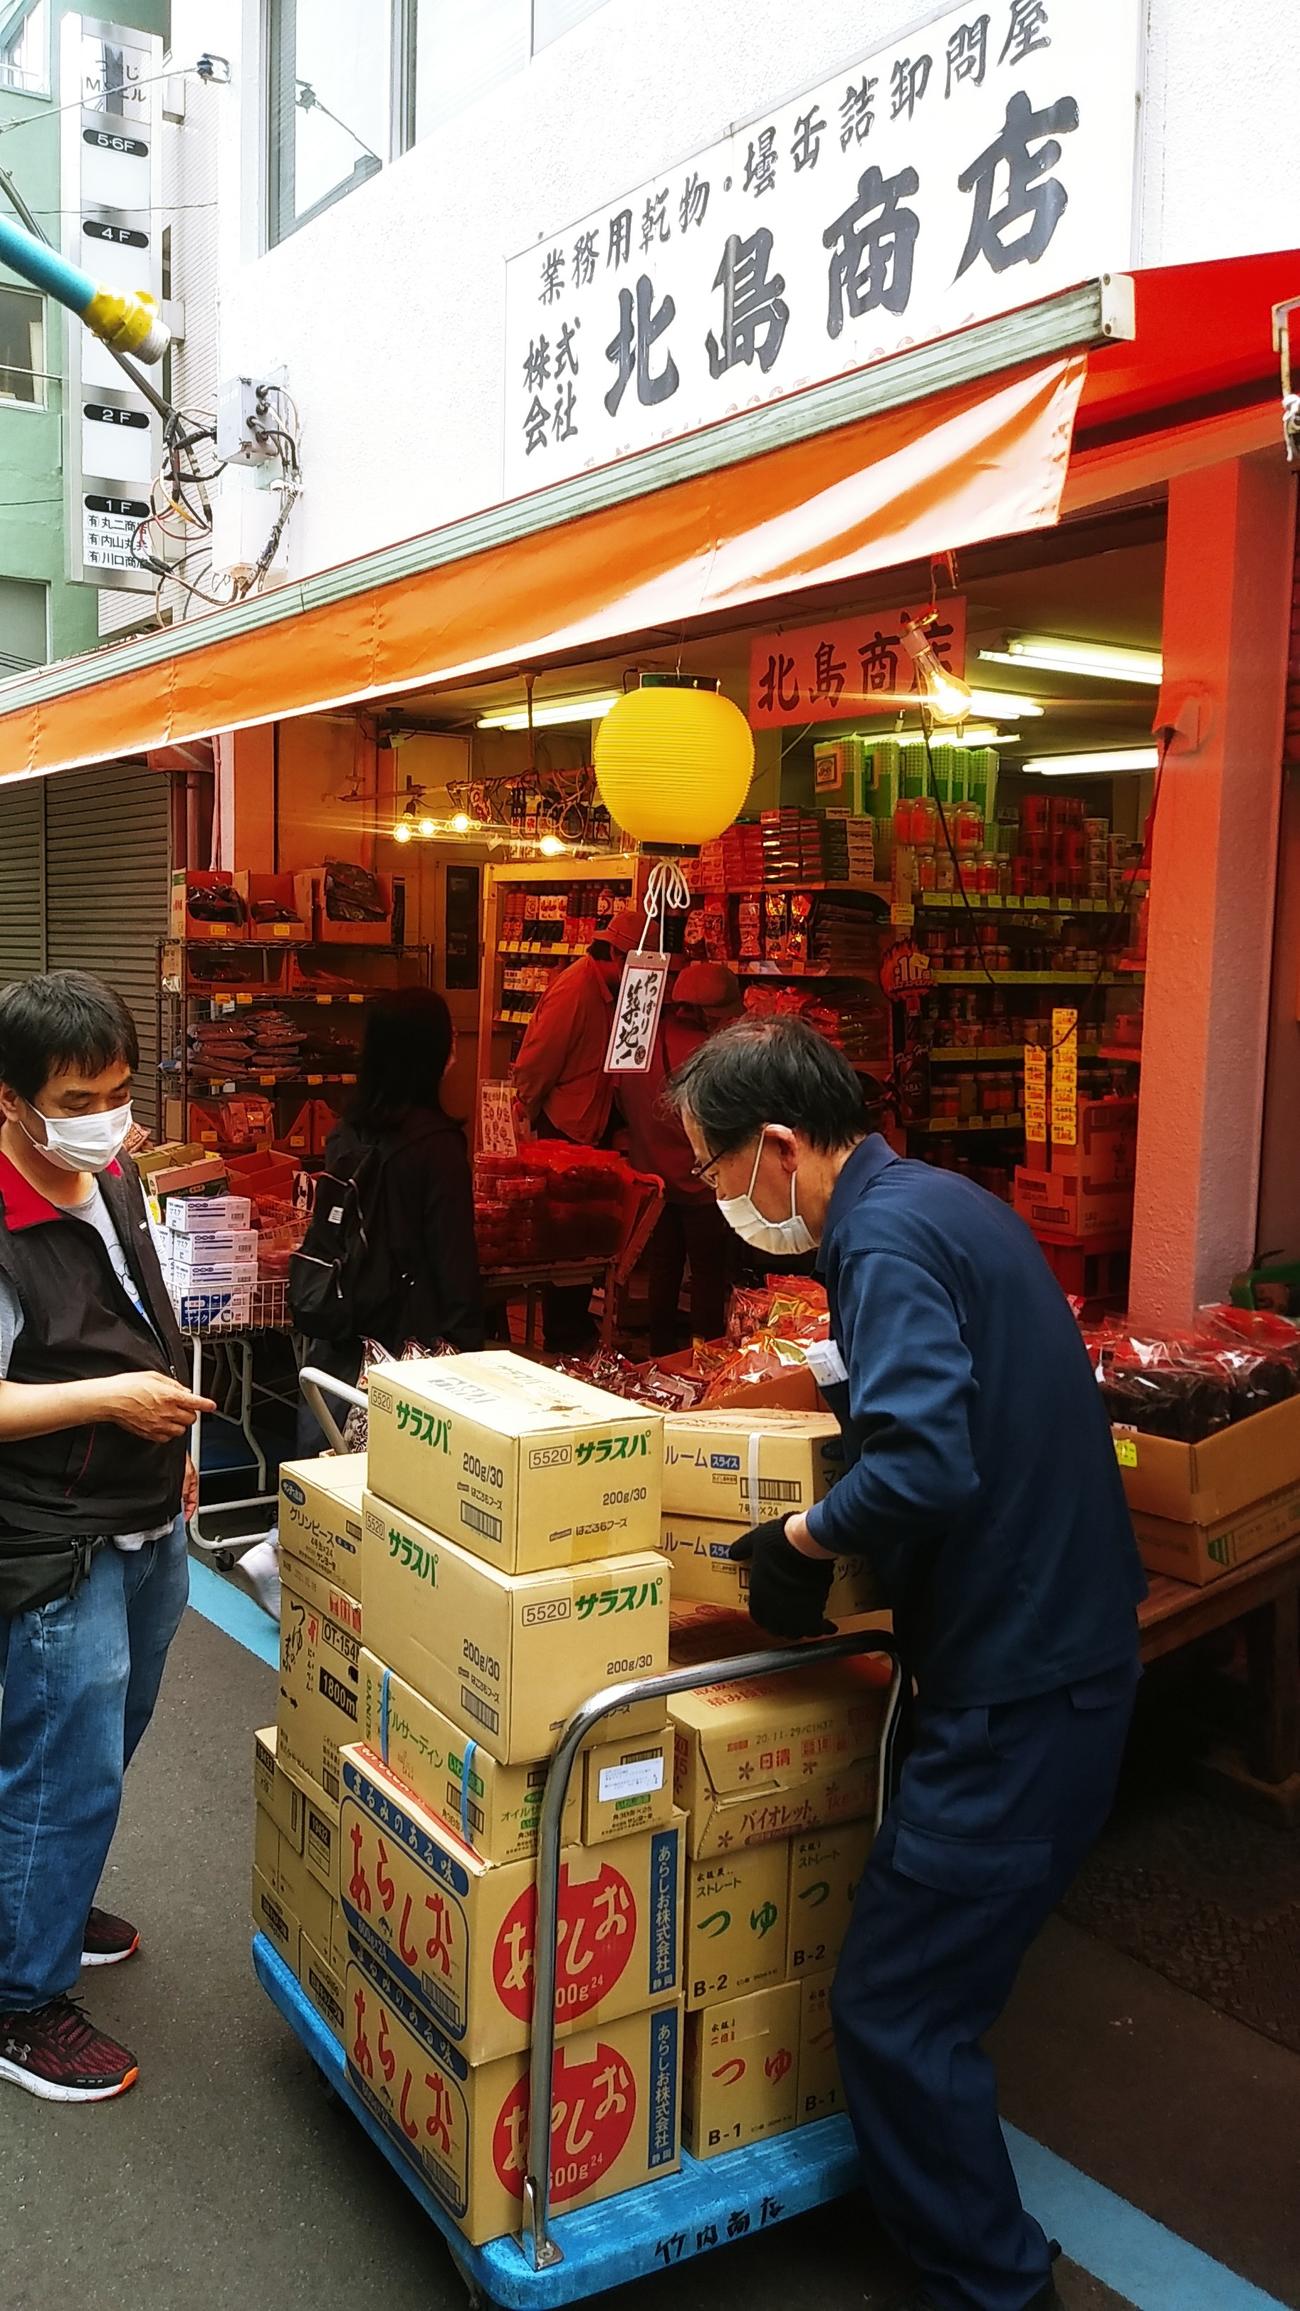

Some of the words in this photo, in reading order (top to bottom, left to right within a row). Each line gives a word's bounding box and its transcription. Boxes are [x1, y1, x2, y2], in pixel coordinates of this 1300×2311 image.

[601, 90, 1080, 418] 北島商店
[372, 1389, 392, 1411] 5520
[395, 1400, 453, 1456] サラスパ
[532, 1449, 569, 1467] 5520
[575, 1429, 652, 1466] サラスパ
[712, 1455, 739, 1469] スライス
[462, 1452, 504, 1489] 200g/30
[602, 1486, 647, 1507] 200g/30
[366, 1513, 386, 1538] 5520
[388, 1527, 439, 1588] サラスパ
[525, 1602, 568, 1624] 5520
[575, 1577, 663, 1621] サラスパ
[463, 1638, 500, 1683] 200g/30
[606, 1654, 653, 1676] 200g/30
[353, 1772, 456, 1888] まるみのある味
[739, 1799, 813, 1834] バイオレット
[349, 1821, 454, 1977] あらしお
[696, 1877, 743, 1899] ストレート
[654, 1846, 672, 1974] あらしお株式会社
[696, 1901, 778, 1940] つゆ
[793, 1944, 826, 1967] B-2
[693, 1974, 729, 1998] B-2
[353, 1988, 454, 2156] あらしお
[653, 2023, 673, 2148] あらしお株式会社
[711, 2047, 793, 2087] つゆ
[804, 2089, 837, 2112] B-1
[708, 2122, 742, 2147] B-1
[655, 2193, 785, 2265] 竹内商店
